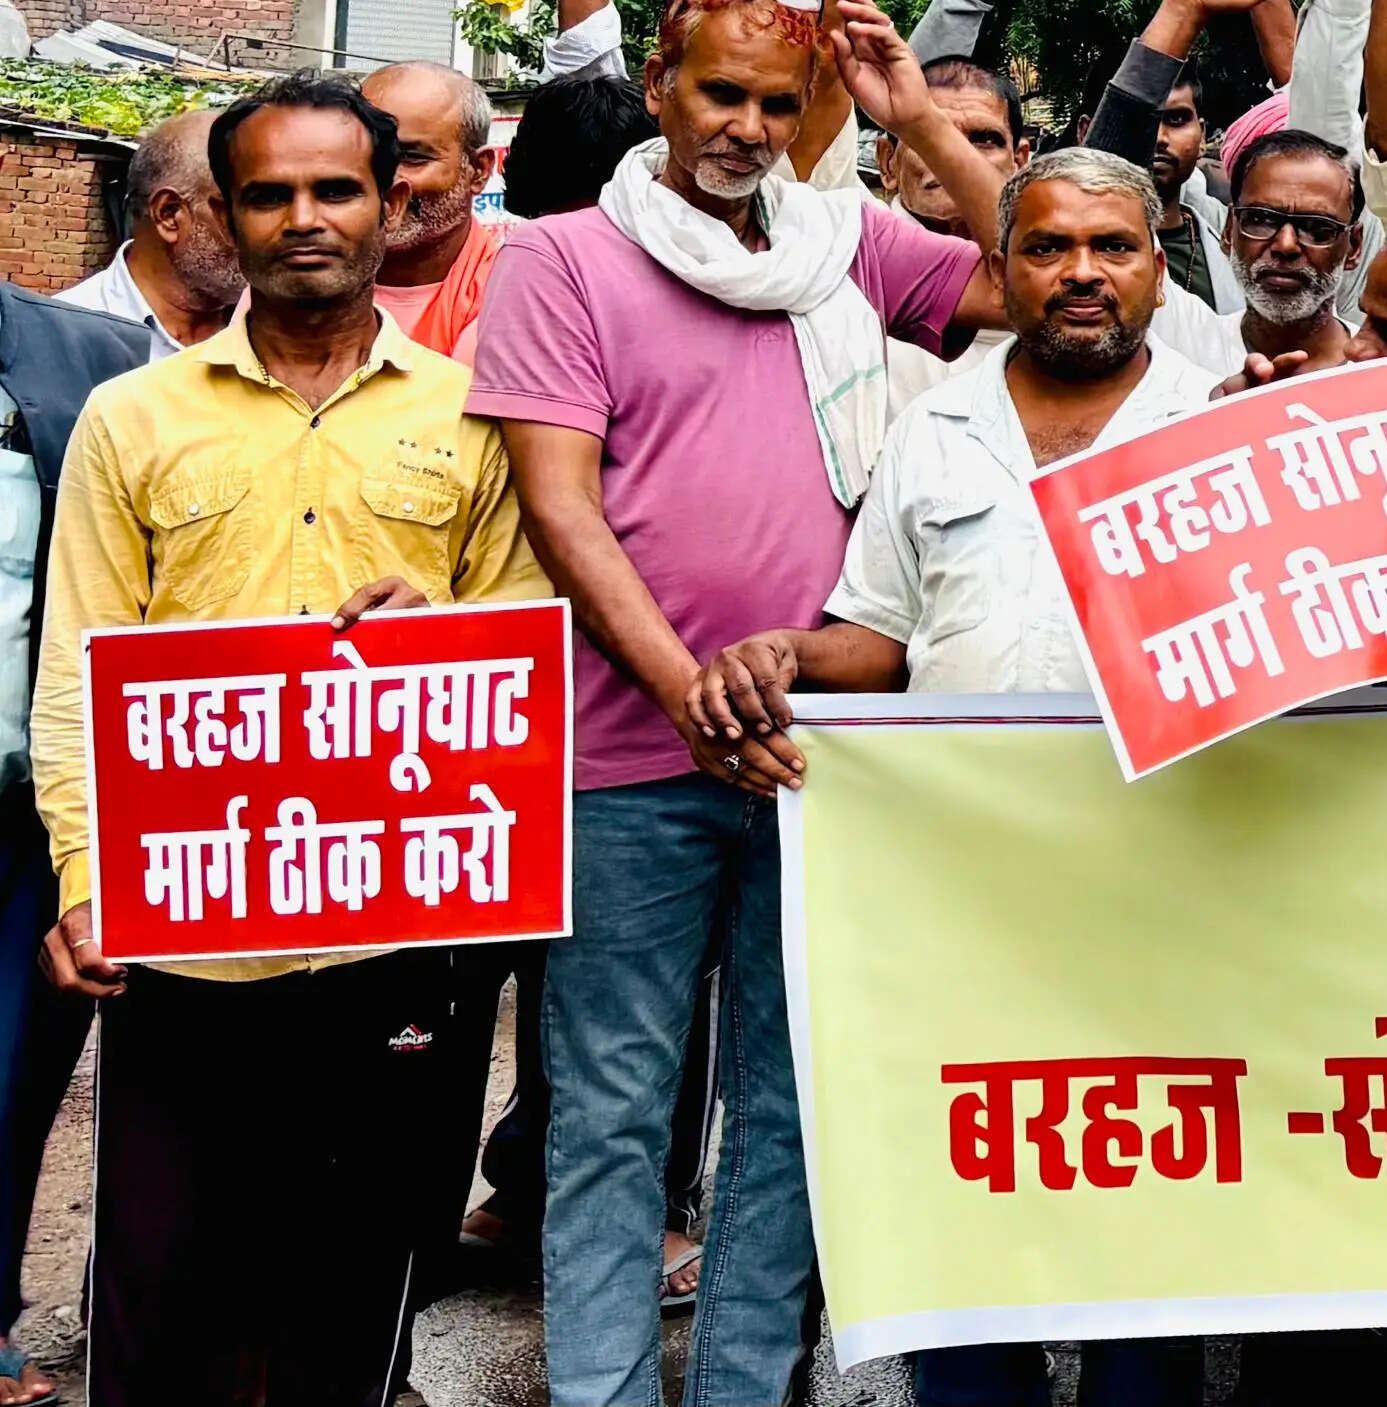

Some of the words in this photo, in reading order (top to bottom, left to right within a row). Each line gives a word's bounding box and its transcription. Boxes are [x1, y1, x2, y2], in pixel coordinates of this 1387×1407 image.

[1077, 444, 1272, 578] बरहज
[1141, 562, 1285, 707] मार्ग
[122, 673, 287, 770] बरहज
[301, 640, 534, 793] सोनूघाट
[140, 795, 251, 922] मार्ग
[265, 796, 385, 915] ठीक
[400, 783, 517, 906] करो
[941, 1056, 1247, 1193] बरहज
